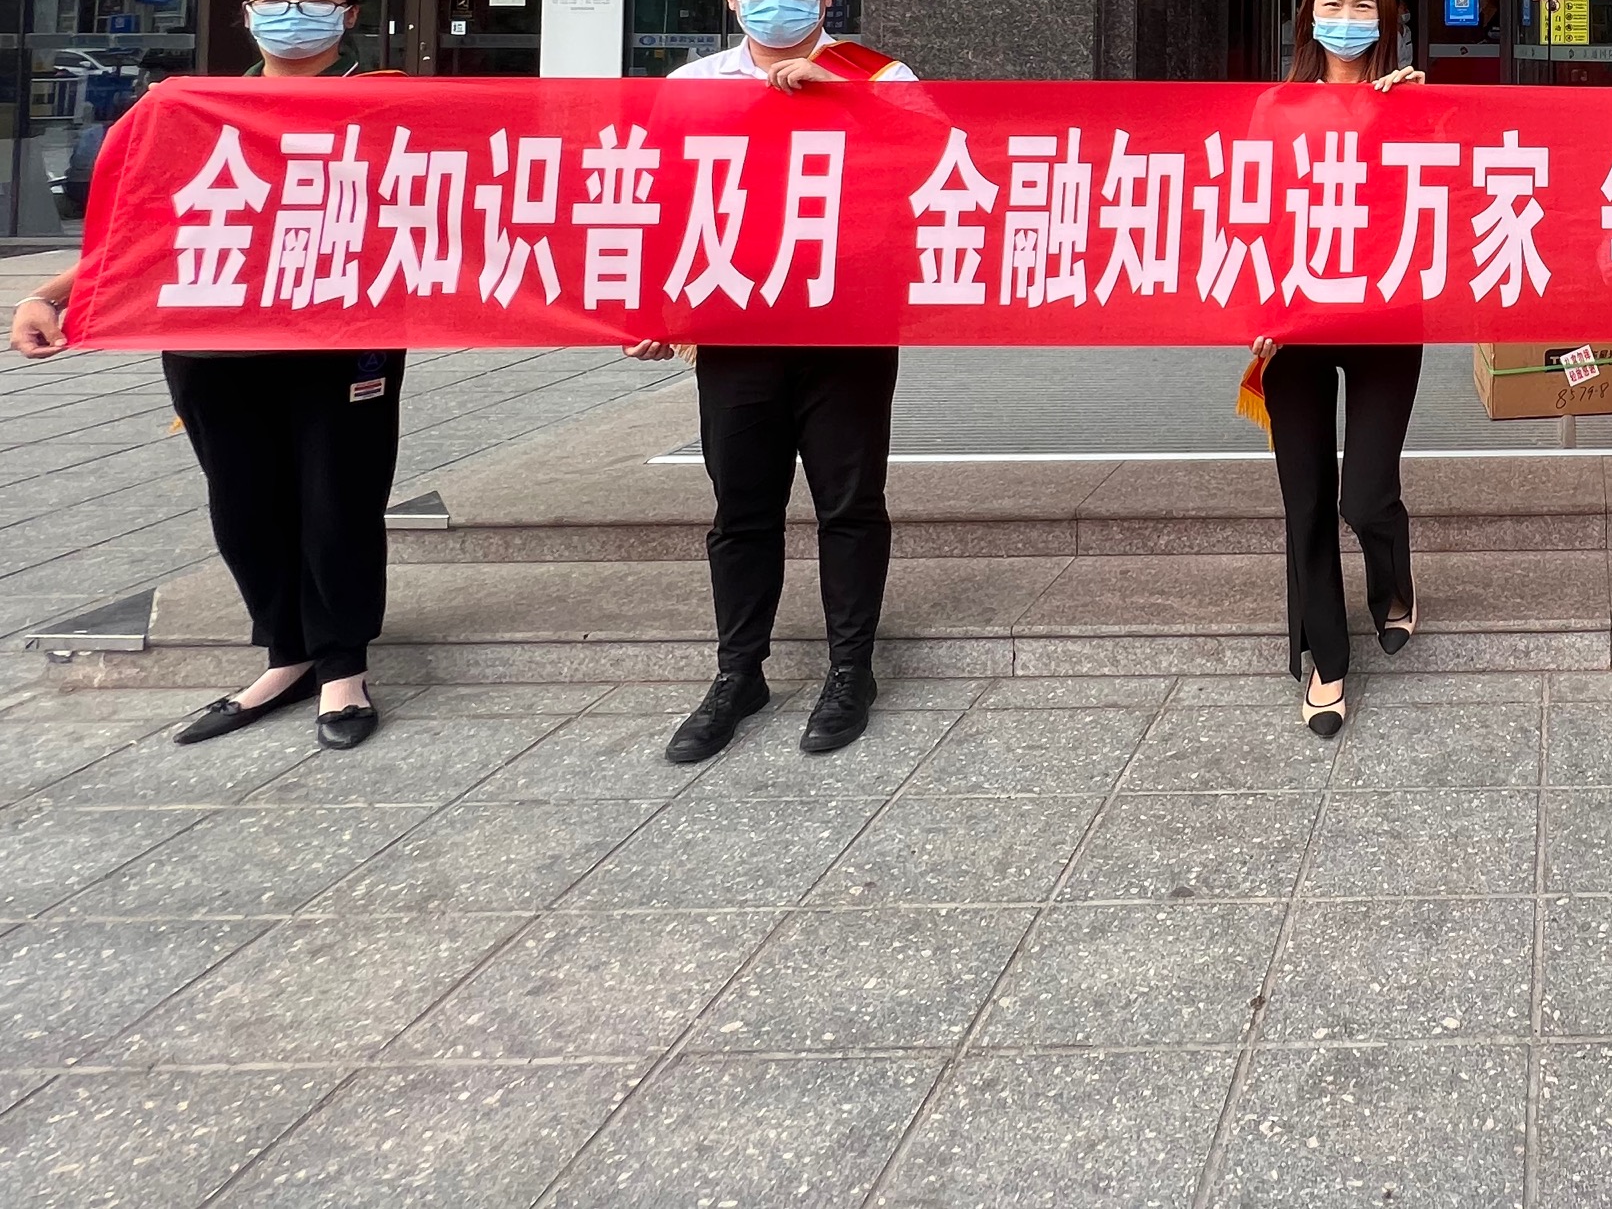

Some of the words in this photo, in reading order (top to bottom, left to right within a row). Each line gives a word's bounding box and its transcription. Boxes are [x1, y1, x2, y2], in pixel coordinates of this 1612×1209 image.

[156, 123, 848, 310] 金融知识普及月
[907, 126, 1553, 310] 金融知识进万家
